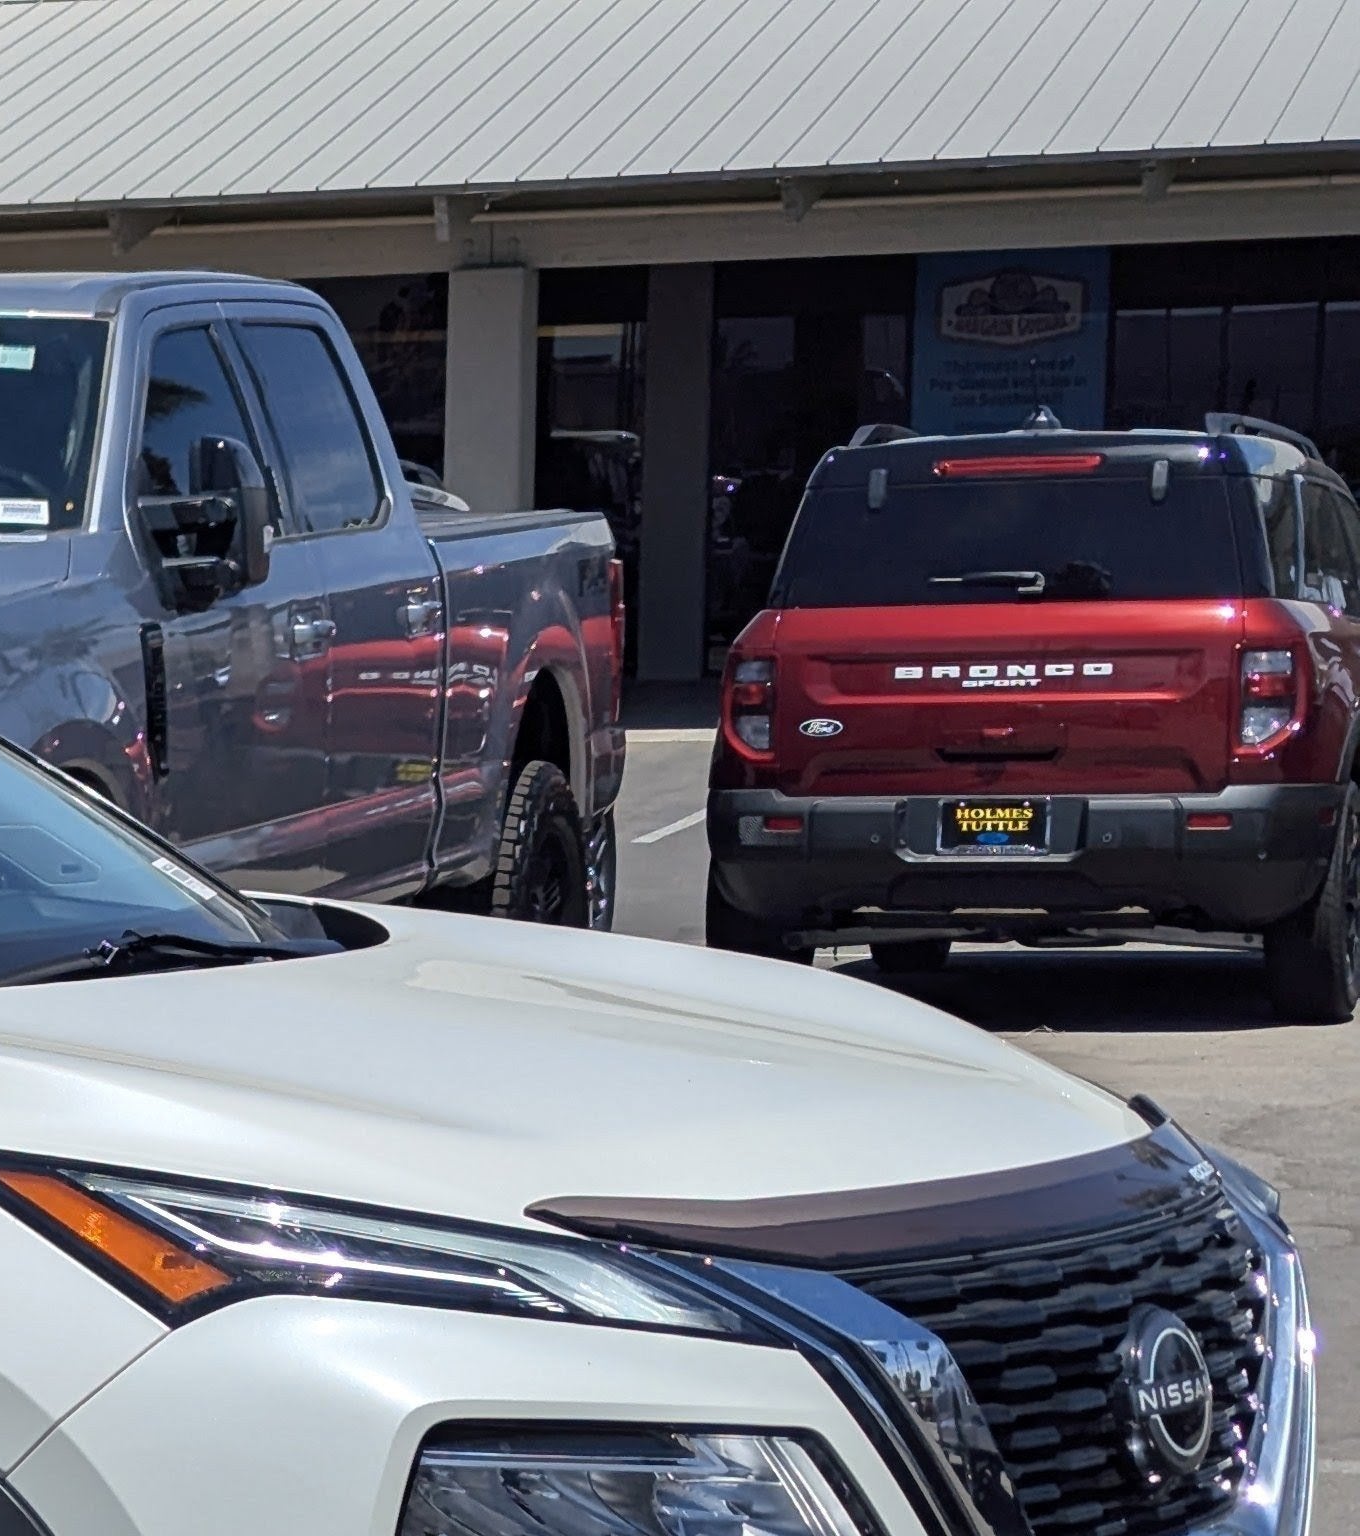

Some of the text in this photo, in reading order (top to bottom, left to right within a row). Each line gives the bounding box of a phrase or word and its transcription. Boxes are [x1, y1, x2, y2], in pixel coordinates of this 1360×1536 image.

[894, 663, 1114, 679] BRONCO
[962, 679, 1042, 688] SPORT
[955, 807, 1034, 820] HOLMES
[959, 820, 1030, 832] TUTTLE
